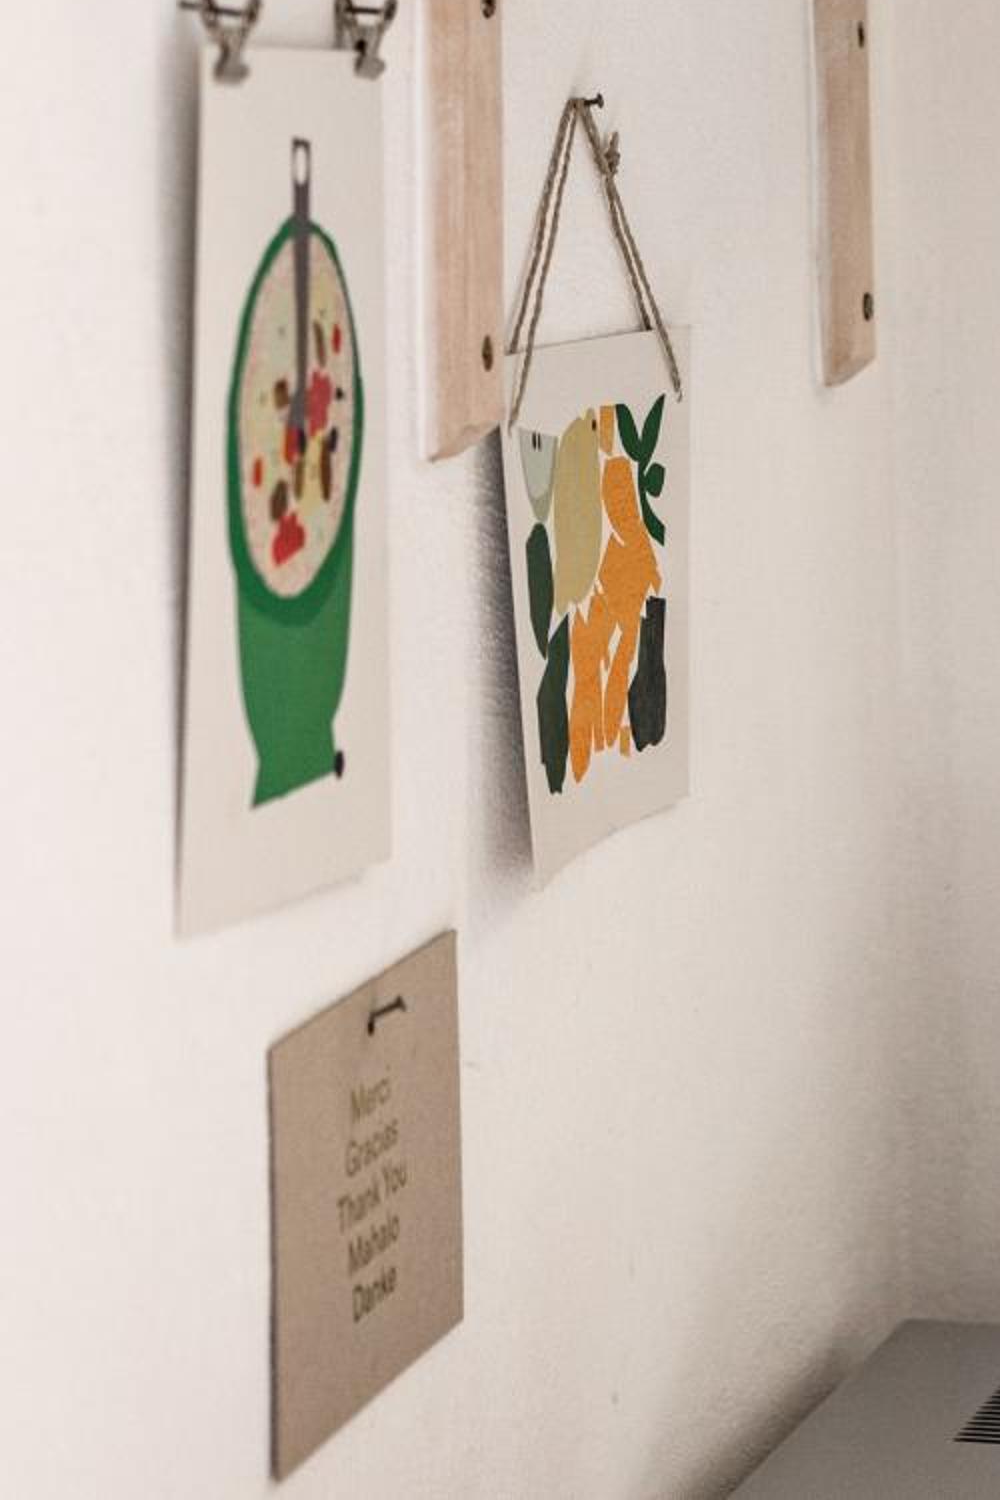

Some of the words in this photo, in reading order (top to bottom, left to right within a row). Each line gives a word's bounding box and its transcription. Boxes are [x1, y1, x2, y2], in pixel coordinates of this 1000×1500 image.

[350, 1063, 391, 1124] Merci
[346, 1116, 399, 1178] Gracias
[337, 1174, 381, 1234] Thank
[380, 1158, 407, 1198] You
[348, 1211, 399, 1277] Mahalo
[352, 1264, 397, 1324] Danke
